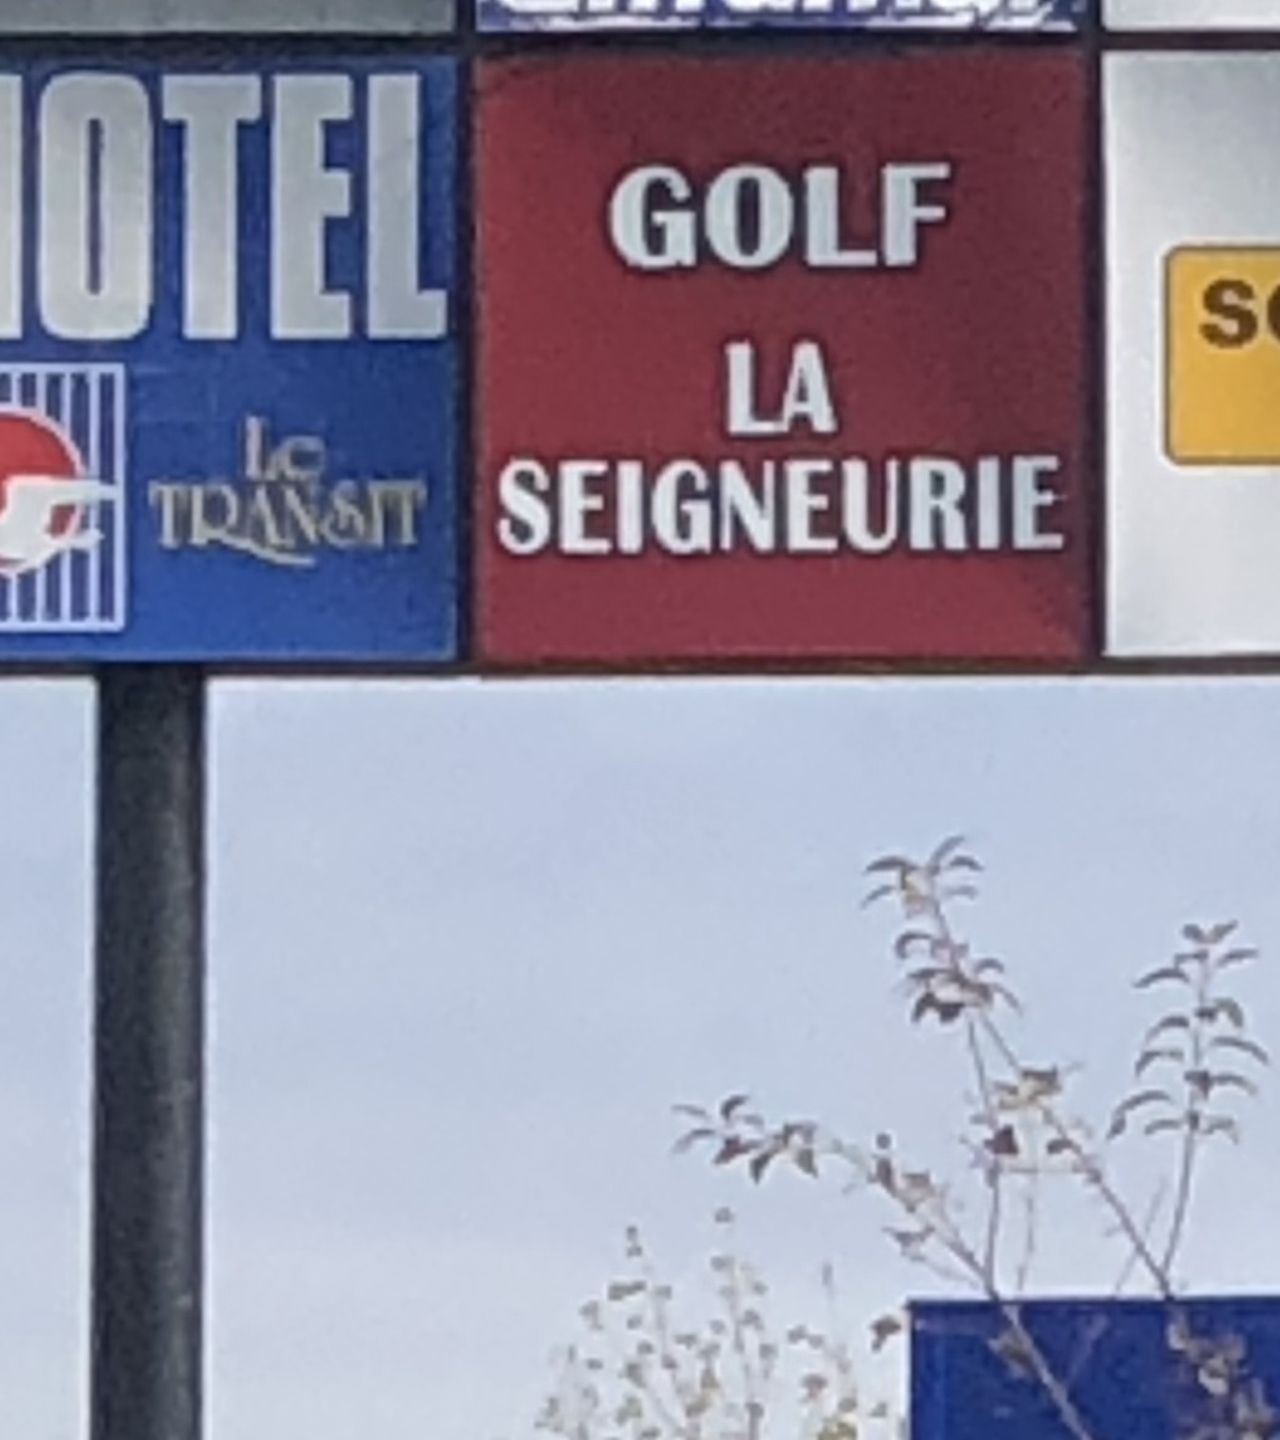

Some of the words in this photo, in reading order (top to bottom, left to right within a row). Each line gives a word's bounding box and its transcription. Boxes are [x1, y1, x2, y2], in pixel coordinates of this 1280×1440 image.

[610, 162, 951, 268] GOLF
[726, 342, 837, 434] LA
[243, 415, 324, 480] Le
[149, 480, 426, 566] TRANSIT
[499, 456, 1065, 553] SEIGNEURIE
